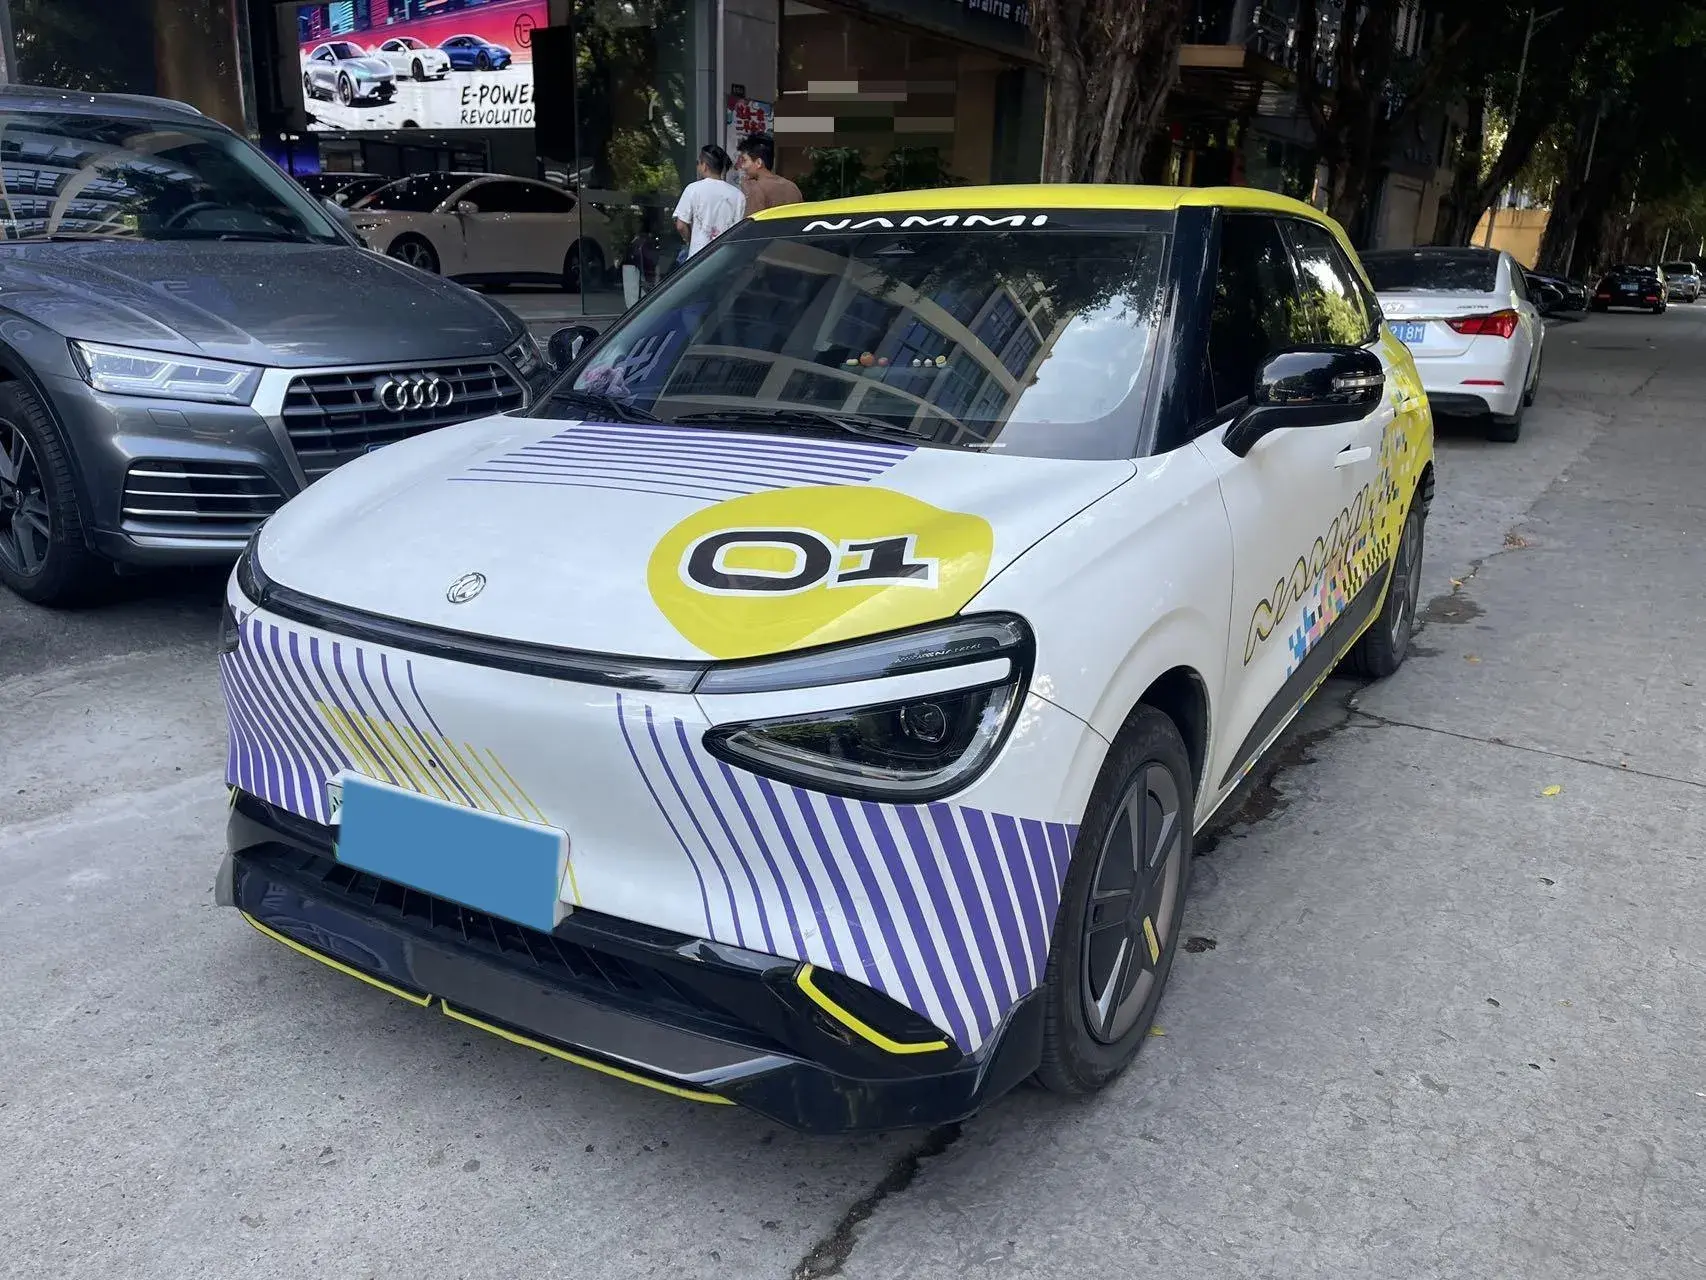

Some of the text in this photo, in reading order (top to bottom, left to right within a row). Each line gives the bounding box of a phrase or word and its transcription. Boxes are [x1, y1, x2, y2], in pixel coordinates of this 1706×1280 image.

[461, 83, 535, 106] E-POWE
[460, 108, 536, 125] REVOLUTIO
[802, 214, 1049, 233] NAMMI
[679, 527, 939, 598] 01
